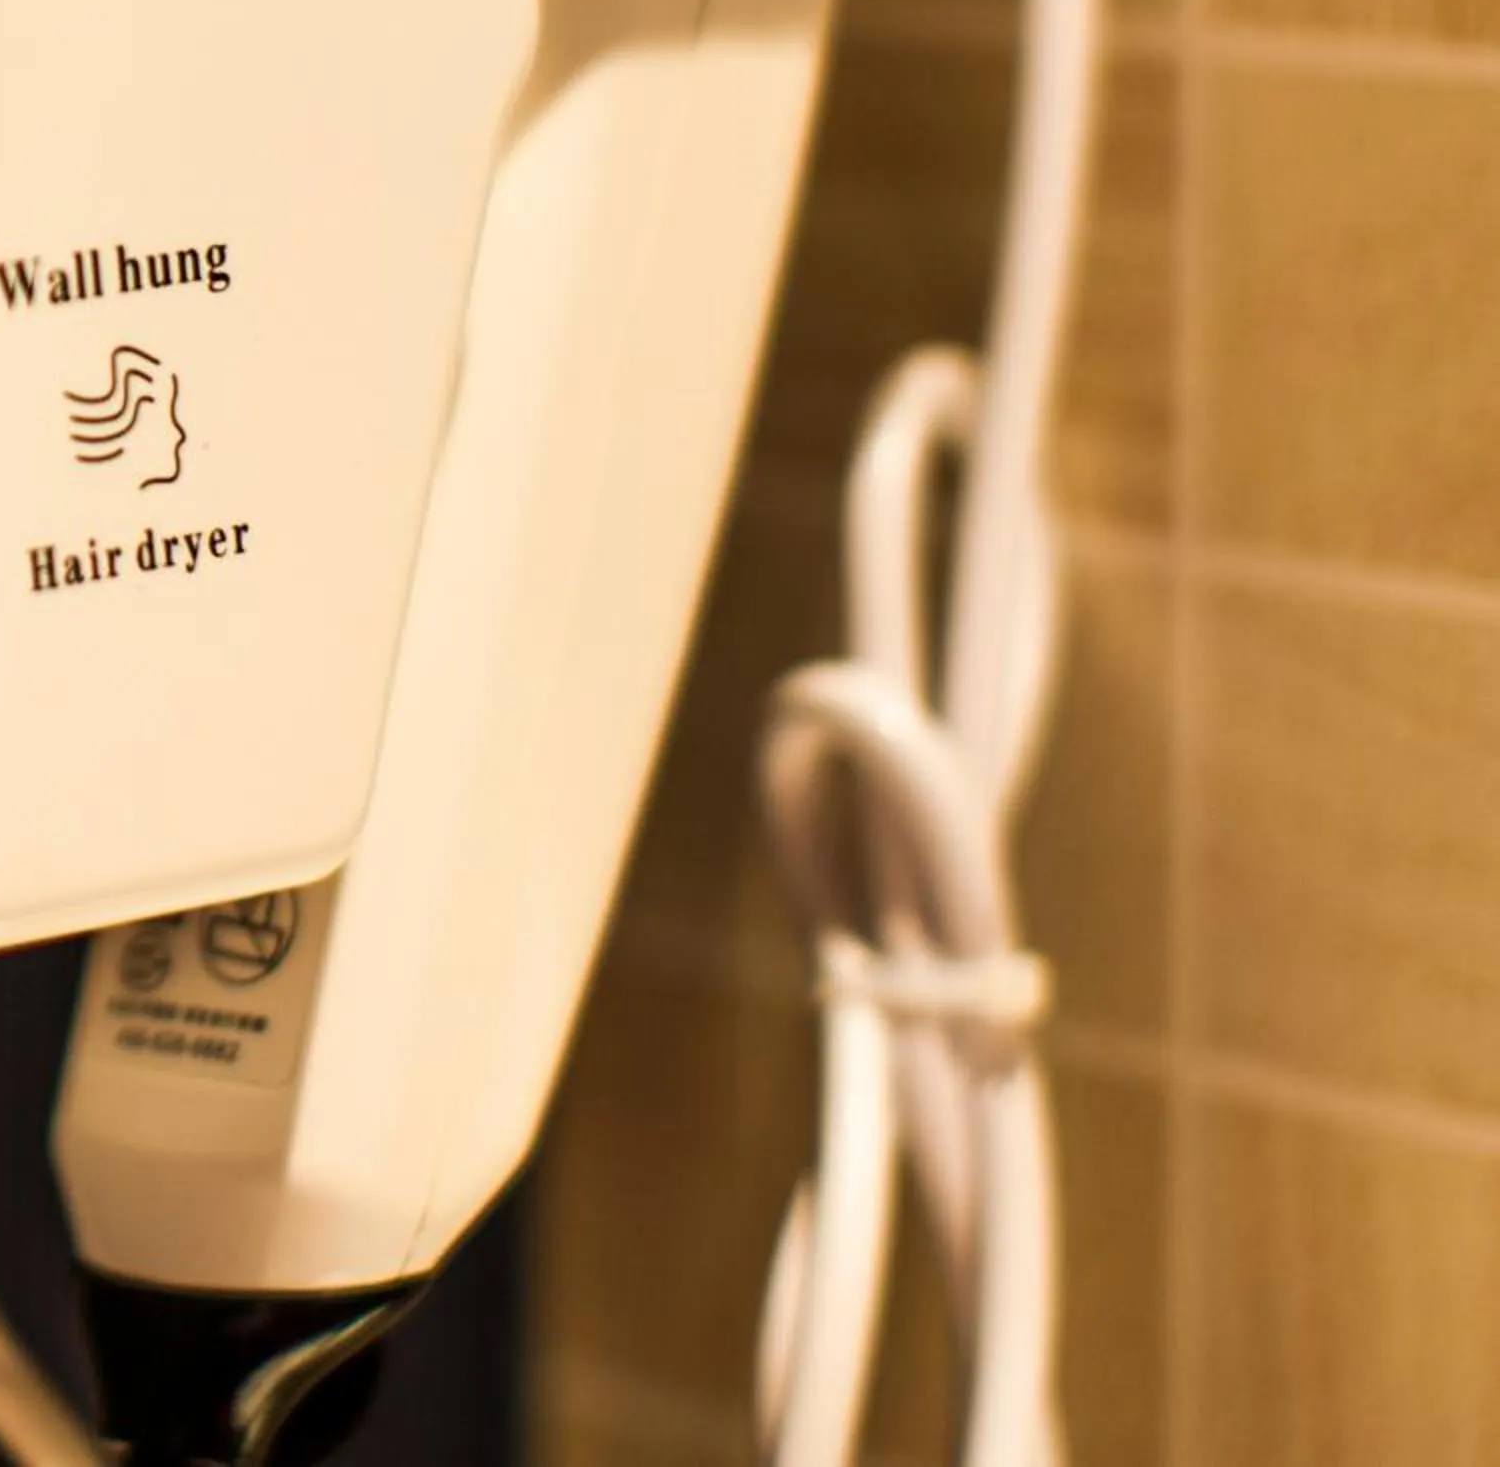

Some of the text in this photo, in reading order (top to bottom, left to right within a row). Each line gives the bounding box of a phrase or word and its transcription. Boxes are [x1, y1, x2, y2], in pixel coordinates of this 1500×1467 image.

[114, 242, 233, 295] hung
[27, 521, 251, 593] Hair dryer
